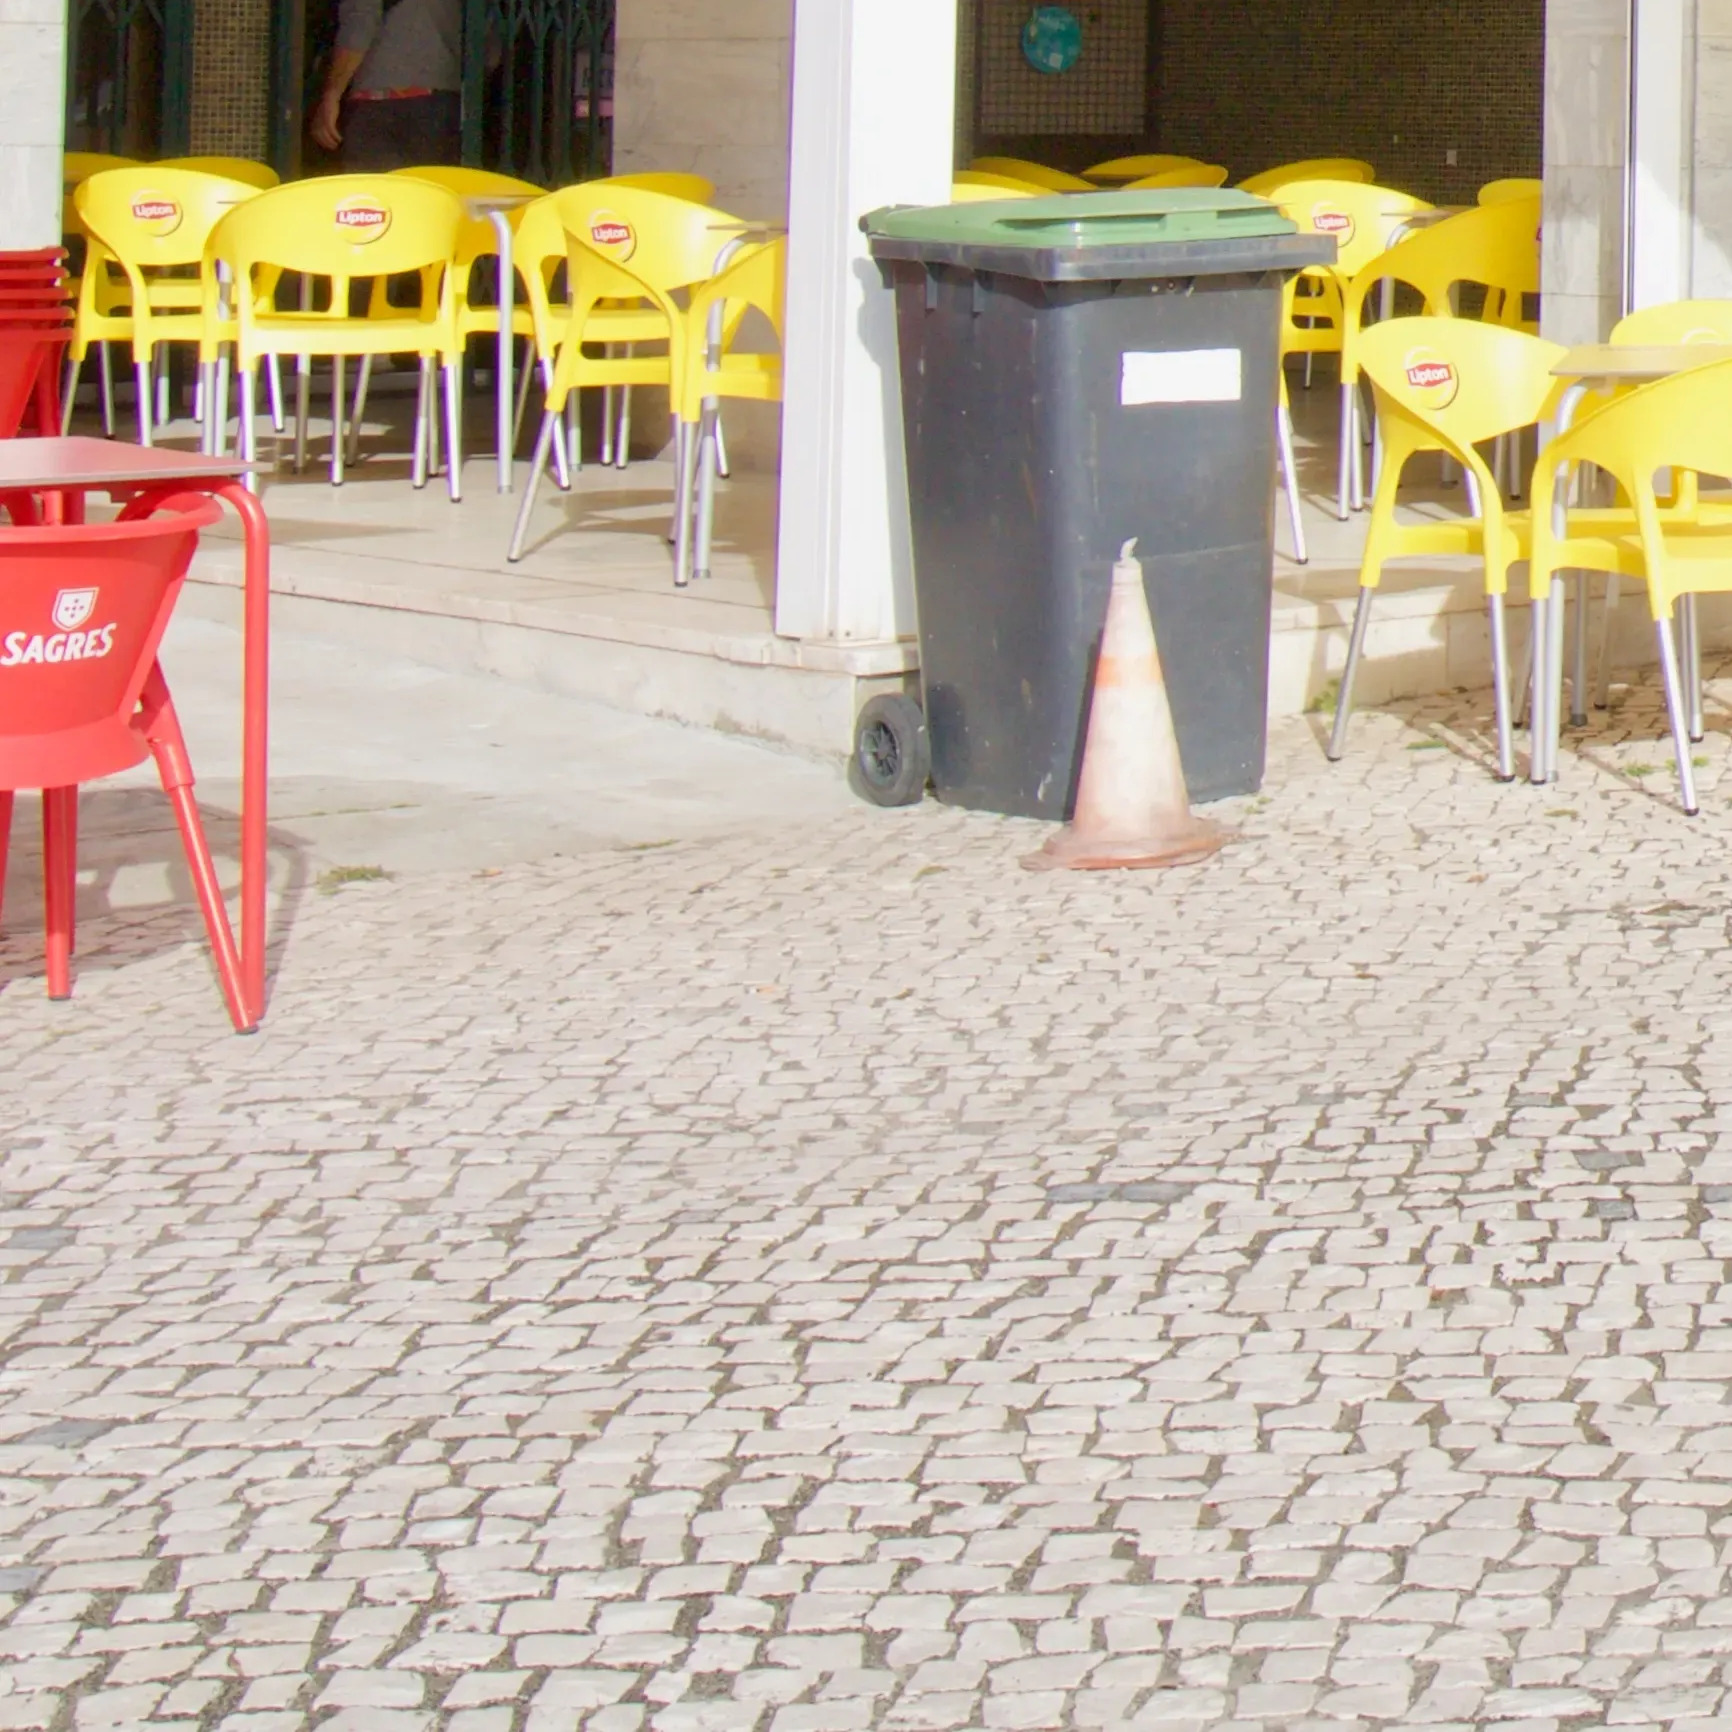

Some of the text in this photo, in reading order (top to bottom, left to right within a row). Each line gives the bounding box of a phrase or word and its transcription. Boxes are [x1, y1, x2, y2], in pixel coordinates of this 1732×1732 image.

[137, 204, 174, 216] Lipton
[340, 211, 381, 223] Lipton
[1316, 215, 1346, 228] Lipton
[595, 227, 626, 238] Lipton
[1409, 367, 1449, 383] Lipton
[0, 623, 118, 666] SAGRES
